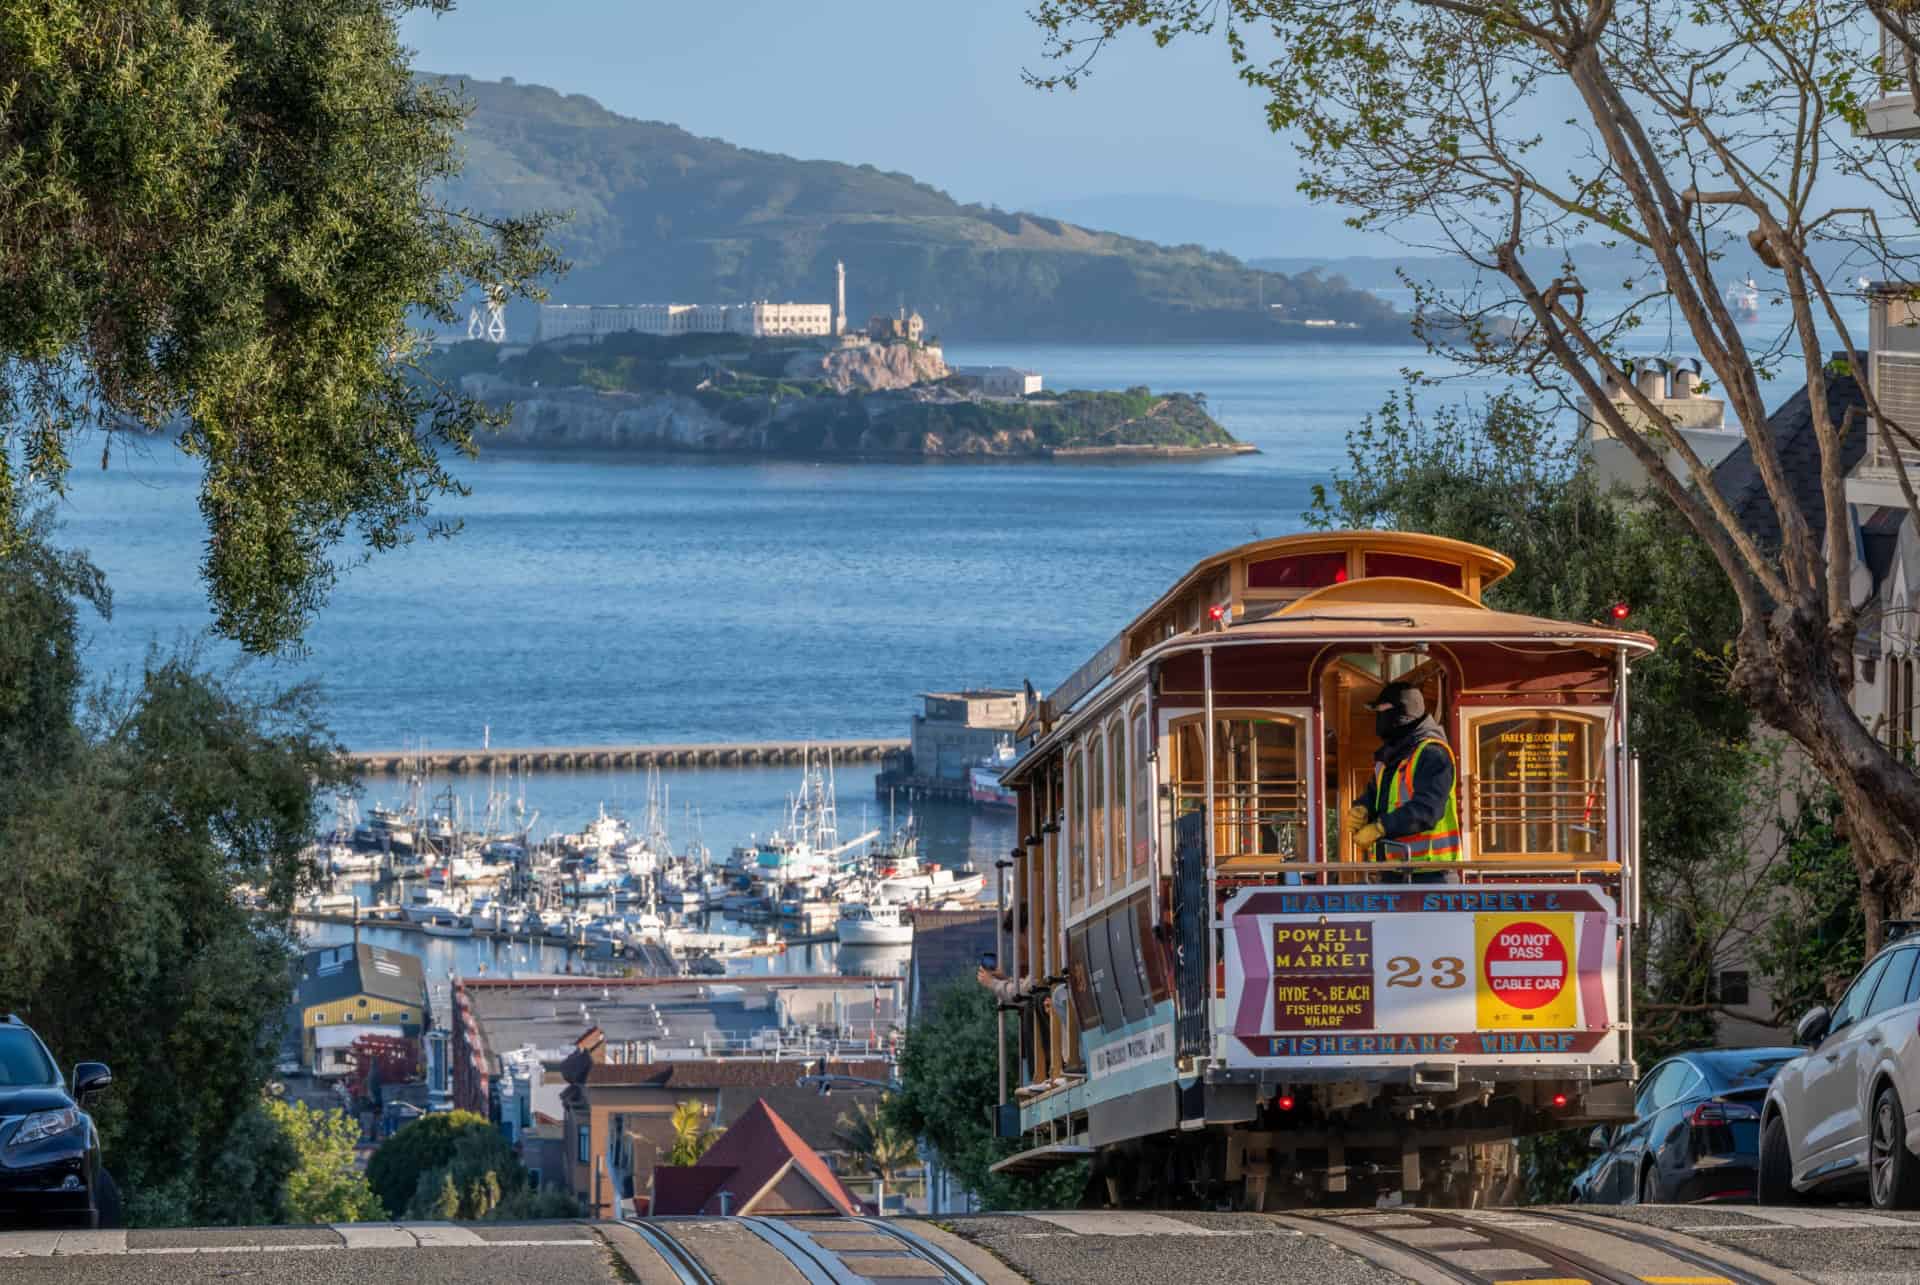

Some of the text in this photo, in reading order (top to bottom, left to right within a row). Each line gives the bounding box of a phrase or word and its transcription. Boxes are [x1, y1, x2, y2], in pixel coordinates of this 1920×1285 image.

[1281, 894, 1401, 912] MARKET
[1423, 891, 1536, 911] STREET
[1278, 928, 1369, 943] POWELL
[1500, 934, 1553, 946] DO NOT
[1301, 942, 1345, 953] AND
[1508, 946, 1544, 959] PASS
[1275, 953, 1369, 968] MARKET
[1386, 955, 1467, 990] 23
[1493, 978, 1561, 990] CABLE CAR
[1279, 986, 1311, 1001] HYDE
[1329, 984, 1370, 1001] BEACH
[1285, 1003, 1363, 1015] FISHERMANS
[1303, 1015, 1345, 1027] WHARF
[1269, 1034, 1576, 1056] FISHERMANS WHARF
